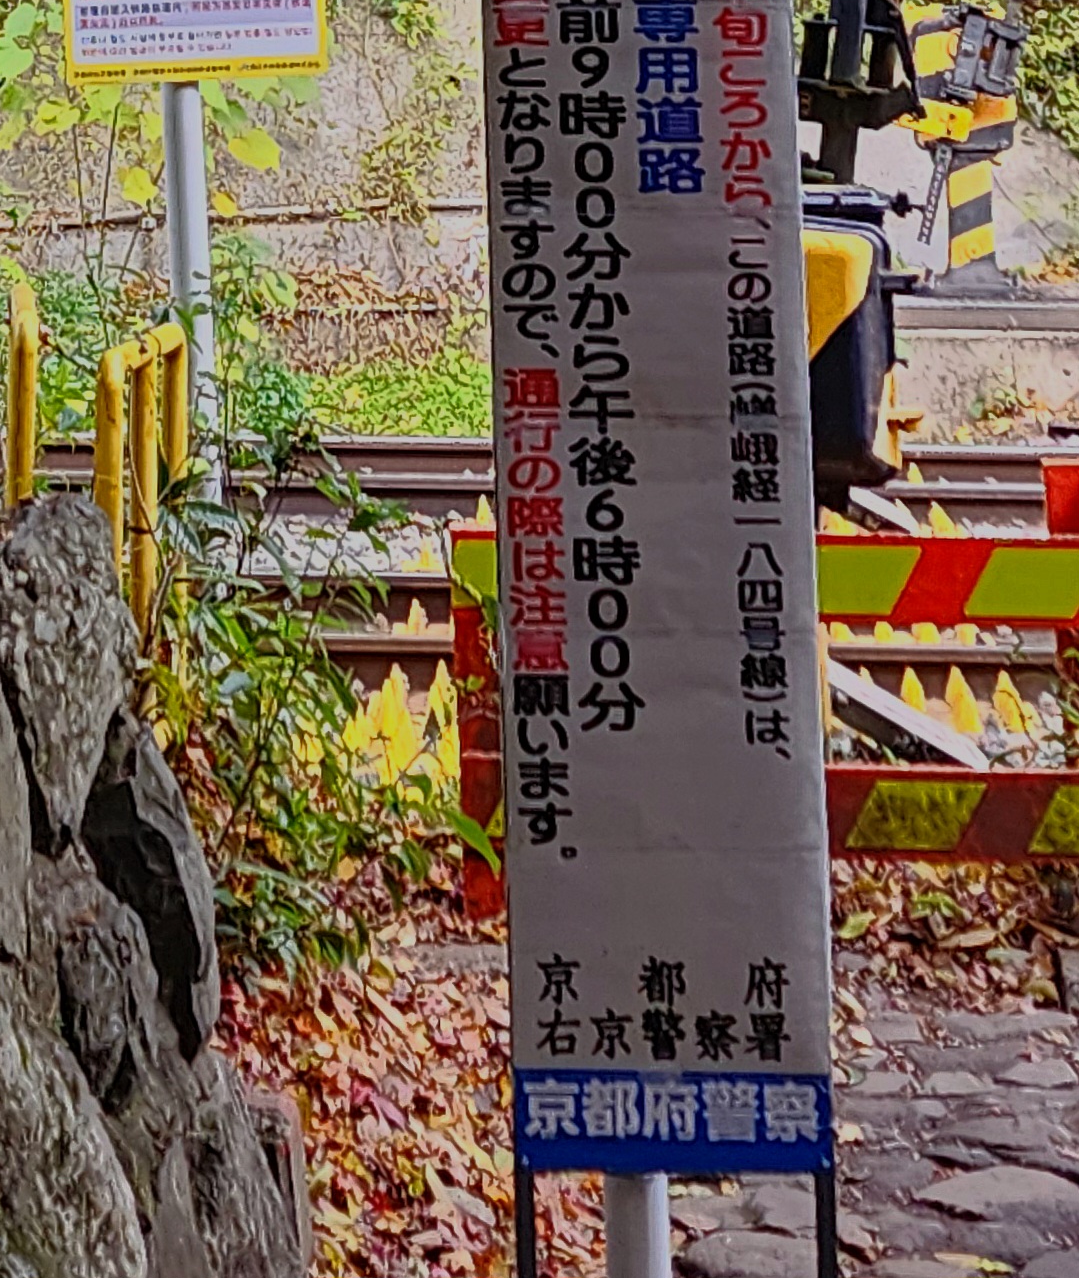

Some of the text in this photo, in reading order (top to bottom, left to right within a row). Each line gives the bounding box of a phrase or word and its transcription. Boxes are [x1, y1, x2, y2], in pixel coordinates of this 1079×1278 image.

[536, 953, 790, 1009] 京都府
[536, 1008, 791, 1063] 右京警察署
[523, 1079, 819, 1143] 京都府警察
